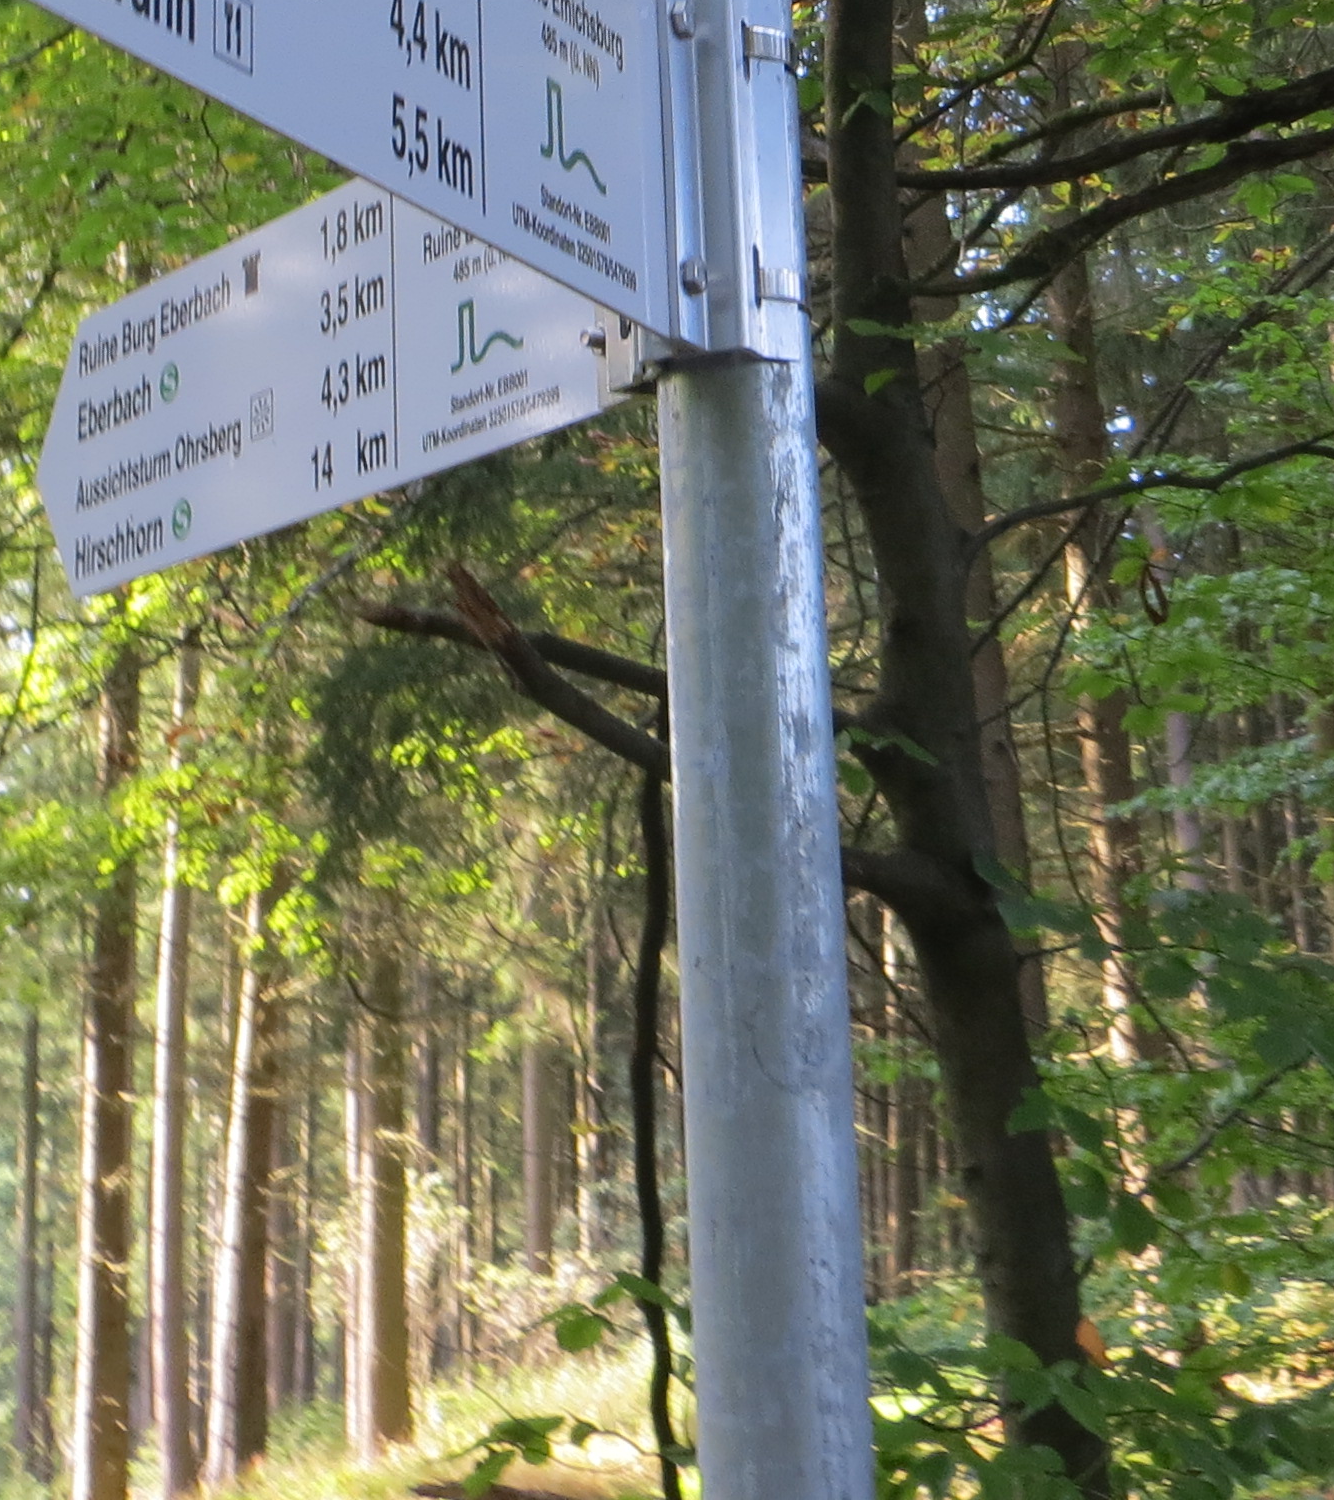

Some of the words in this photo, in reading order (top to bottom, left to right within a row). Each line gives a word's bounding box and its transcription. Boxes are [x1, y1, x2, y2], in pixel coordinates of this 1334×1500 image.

[435, 8, 470, 91] km
[392, 92, 429, 178] 5,5
[437, 117, 473, 198] km
[320, 209, 347, 265] 1,8
[354, 200, 383, 245] km
[423, 226, 460, 265] Ruine
[454, 257, 470, 283] 485
[472, 256, 482, 275] m
[79, 334, 117, 378] Ruine
[122, 315, 156, 356] Burg
[160, 272, 230, 338] Eberbach
[320, 281, 348, 339] 3,5
[355, 273, 384, 320] km
[78, 374, 152, 443] Eberbach
[321, 359, 349, 419] 4,3
[356, 353, 386, 399] km
[76, 448, 171, 512] Aussichtsturm
[175, 419, 242, 471] Ohrsberg
[311, 440, 333, 492] 14
[357, 428, 387, 476] km
[75, 516, 163, 580] Hirschhorn
